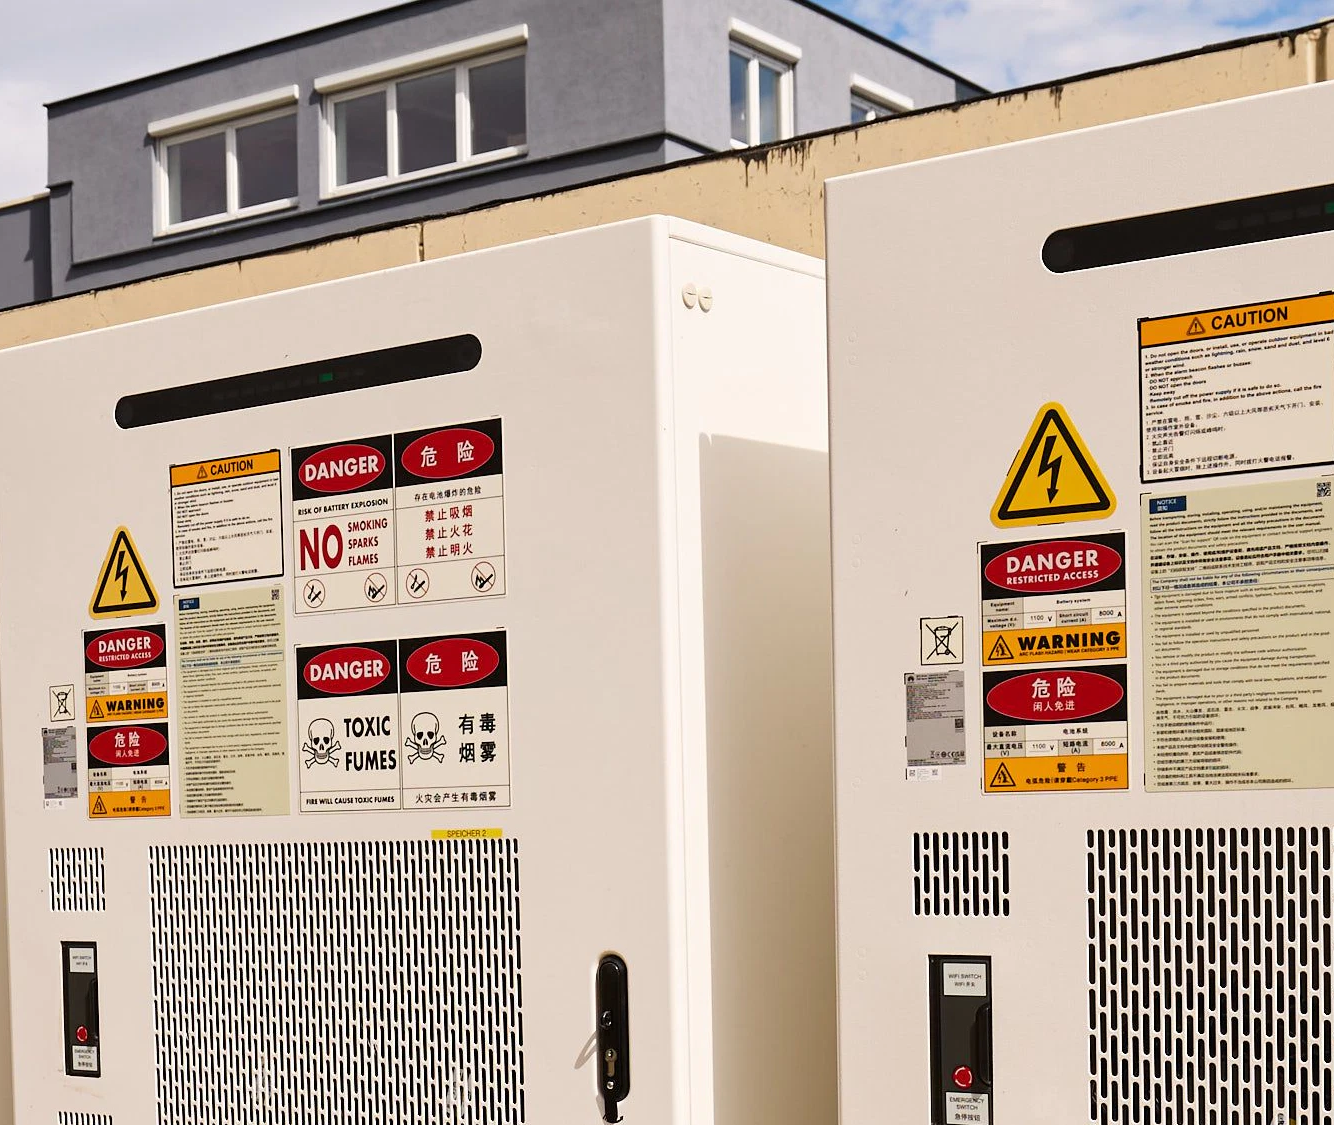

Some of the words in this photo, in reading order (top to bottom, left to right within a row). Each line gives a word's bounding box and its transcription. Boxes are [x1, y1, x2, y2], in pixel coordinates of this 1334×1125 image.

[1211, 306, 1288, 330] CAUTION
[420, 440, 475, 468] 危险
[211, 460, 253, 475] CAUTION
[304, 455, 379, 482] DANGER
[297, 507, 313, 516] RISK
[313, 505, 322, 514] OF
[323, 502, 350, 513] BATTERY
[351, 498, 388, 510] EXPLOSION
[425, 505, 473, 523] 禁止吸烟
[347, 518, 388, 533] SMOKING
[425, 524, 473, 541] 禁止火花
[299, 524, 344, 571] NO
[348, 536, 379, 550] SPARKS
[425, 542, 473, 559] 禁止明火
[348, 554, 379, 567] FLAMES
[1006, 549, 1099, 574] DANGER
[1007, 574, 1060, 585] RESTRICTED
[1063, 570, 1099, 581] ACCESS
[99, 636, 152, 654] DANGER
[1018, 631, 1120, 650] WARNING
[99, 653, 130, 663] RESTRICTED
[425, 650, 479, 675] 危险
[310, 659, 384, 682] DANGER
[1031, 676, 1076, 699] 危险
[106, 697, 165, 712] WARNING
[1033, 700, 1075, 712] 闲人免进
[344, 716, 391, 738] TOXIC
[458, 713, 496, 735] 有毒
[114, 732, 140, 748] 危险
[345, 750, 397, 771] FUMES
[459, 741, 496, 763] 烟雾
[1057, 762, 1086, 773] 警告
[447, 830, 480, 838] SPEICHER
